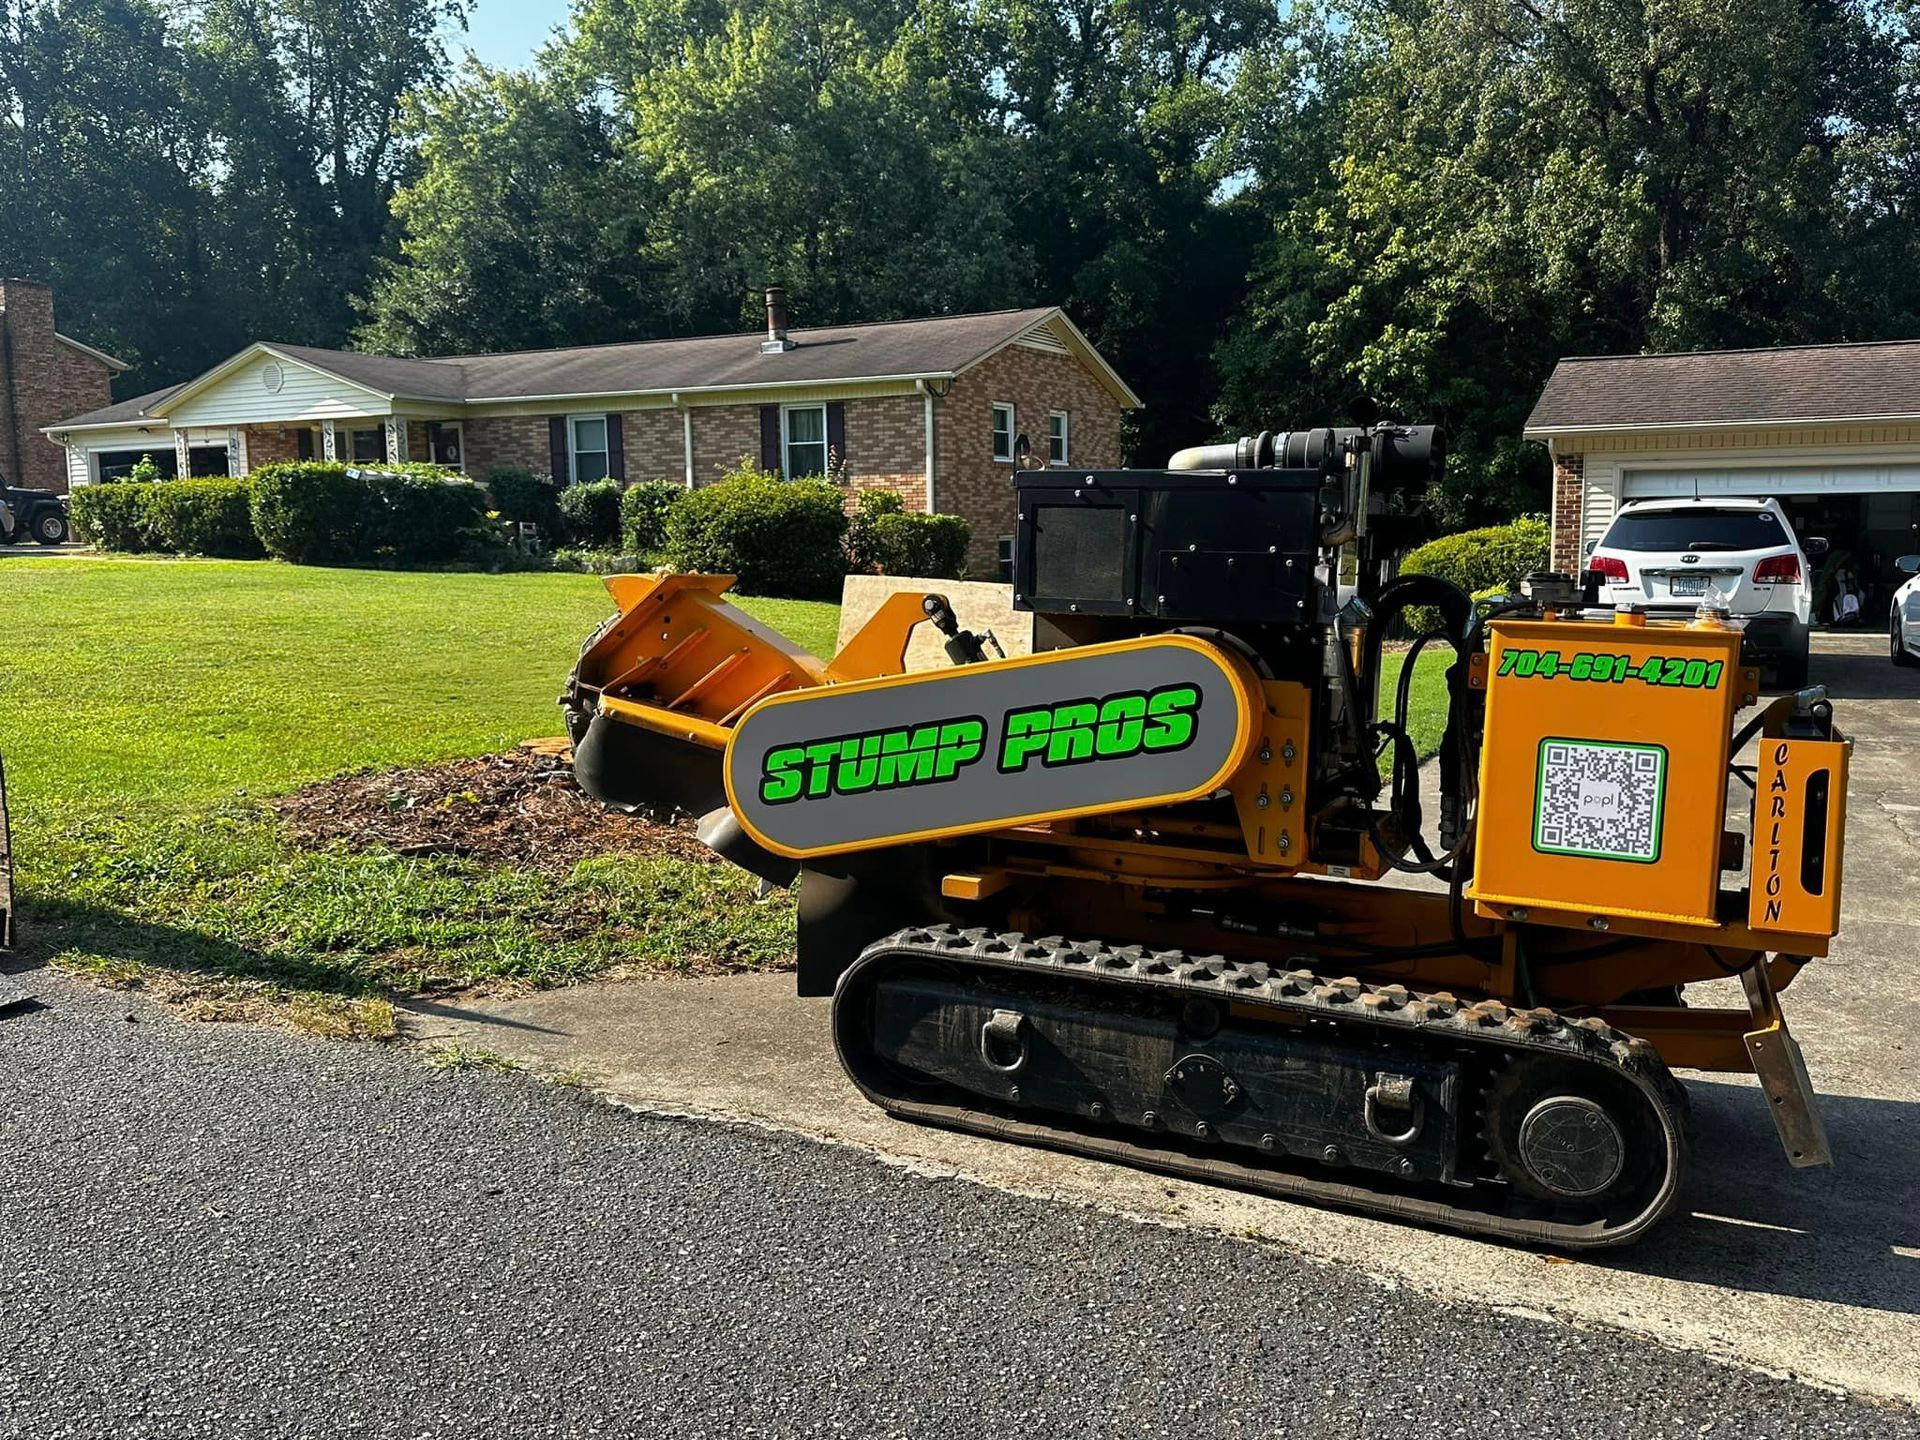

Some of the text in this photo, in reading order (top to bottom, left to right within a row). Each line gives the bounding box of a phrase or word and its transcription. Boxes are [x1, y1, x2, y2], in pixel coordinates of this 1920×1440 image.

[1497, 650, 1723, 689] 704-691-4201
[760, 685, 1200, 804] STUMP PROS
[1583, 792, 1614, 808] popl
[1763, 742, 1789, 924] CARLTON
